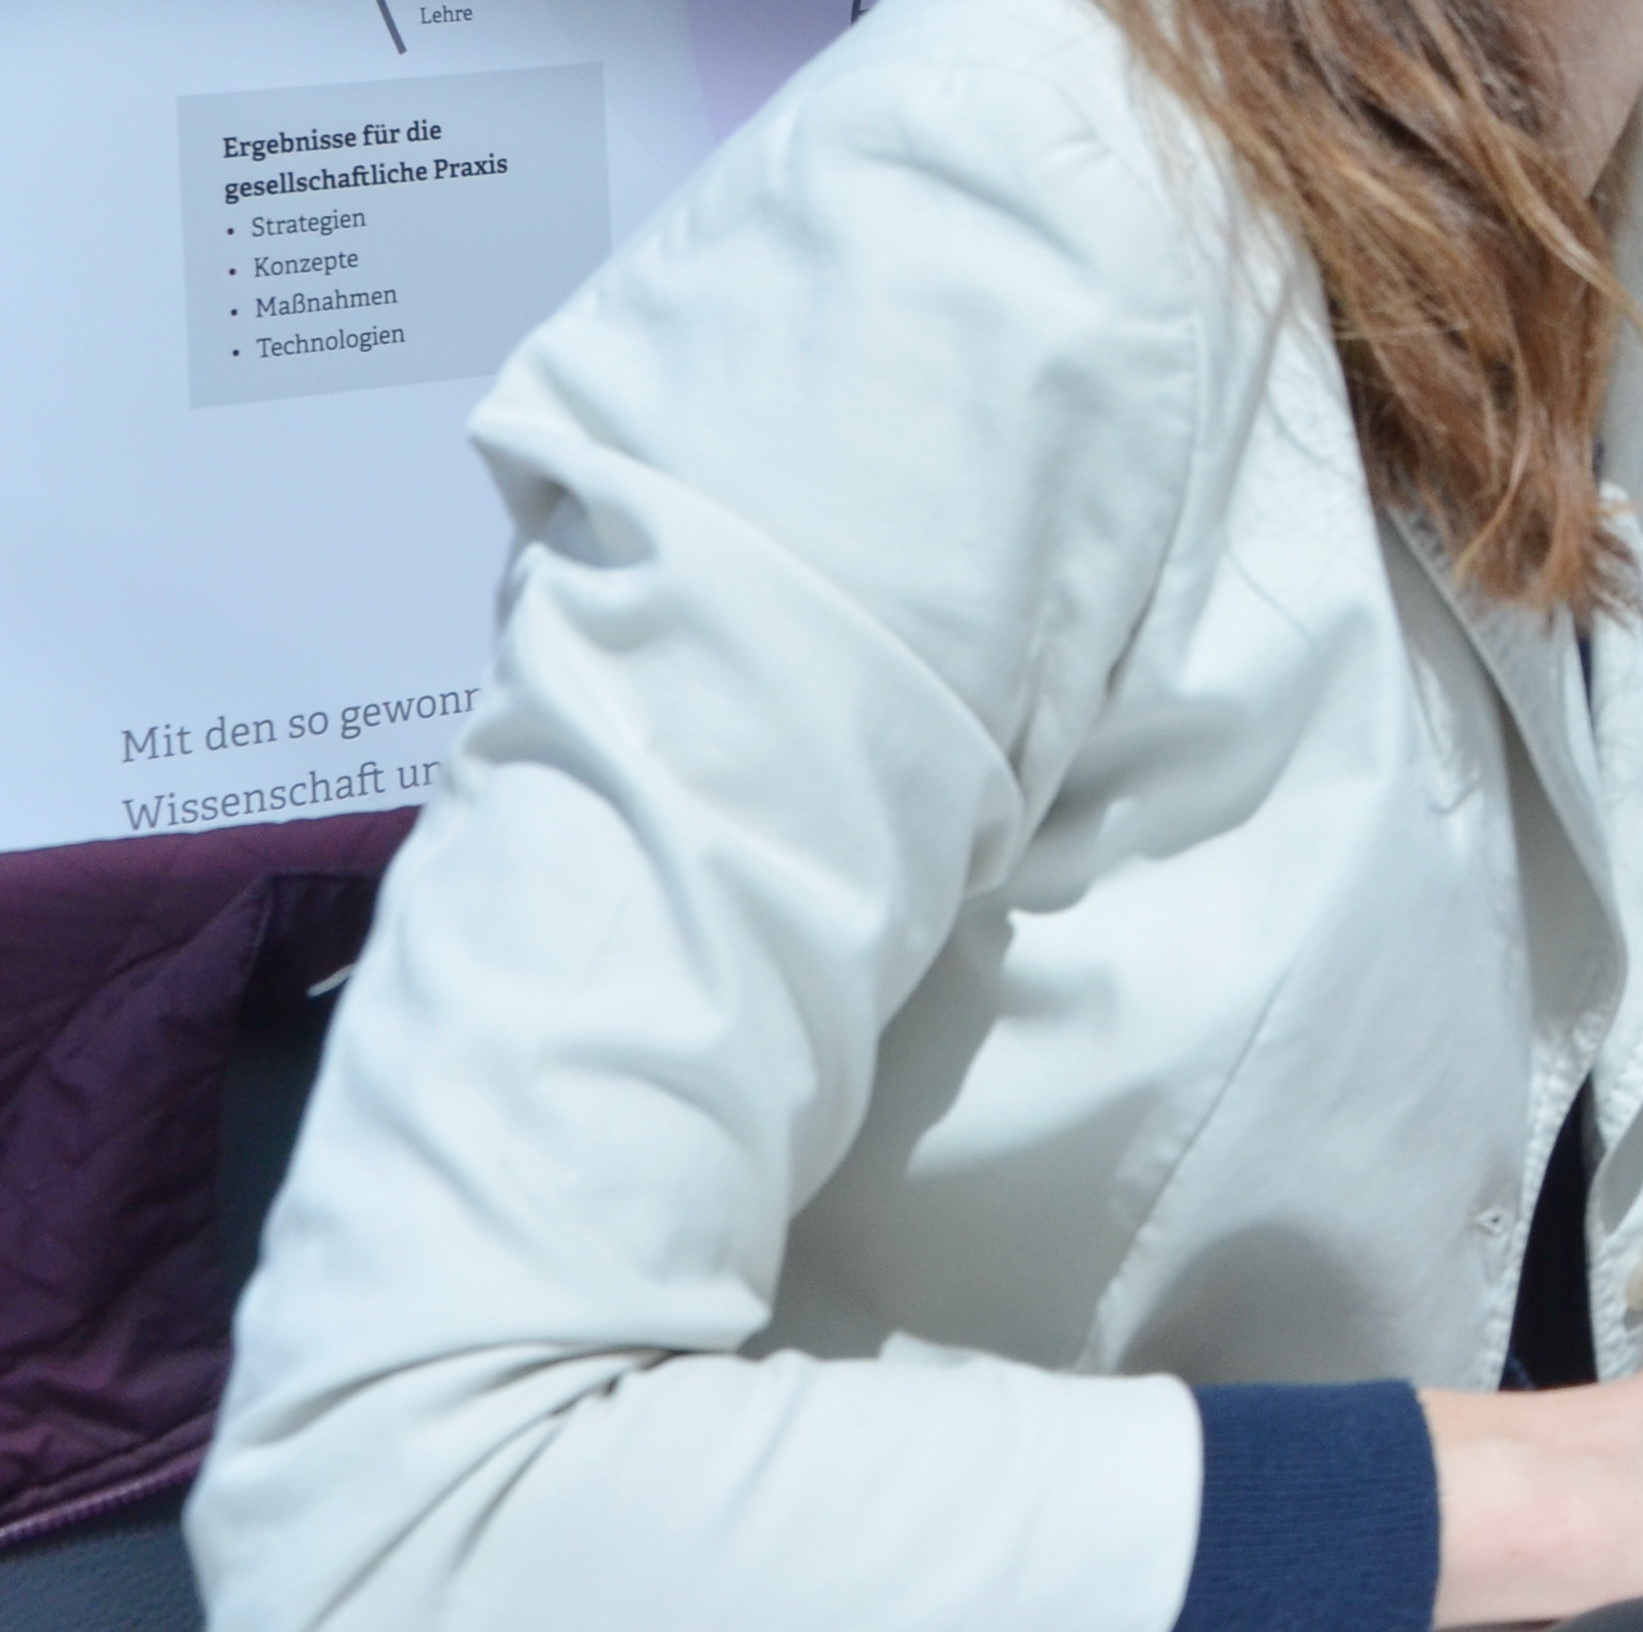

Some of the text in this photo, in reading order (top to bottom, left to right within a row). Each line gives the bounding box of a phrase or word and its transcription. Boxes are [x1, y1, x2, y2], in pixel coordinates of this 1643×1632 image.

[421, 5, 472, 24] Lehre
[223, 119, 441, 161] Ergebnisse für die
[225, 153, 507, 204] gesellschaftliche Praxis
[252, 209, 366, 237] Strategien
[254, 252, 358, 277] Konzepte
[256, 289, 397, 318] Maßnahmen
[256, 326, 405, 358] Technologien
[121, 724, 192, 762] Mit
[206, 716, 277, 751] den
[289, 712, 328, 738] so
[122, 761, 385, 830] Wissenschaft
